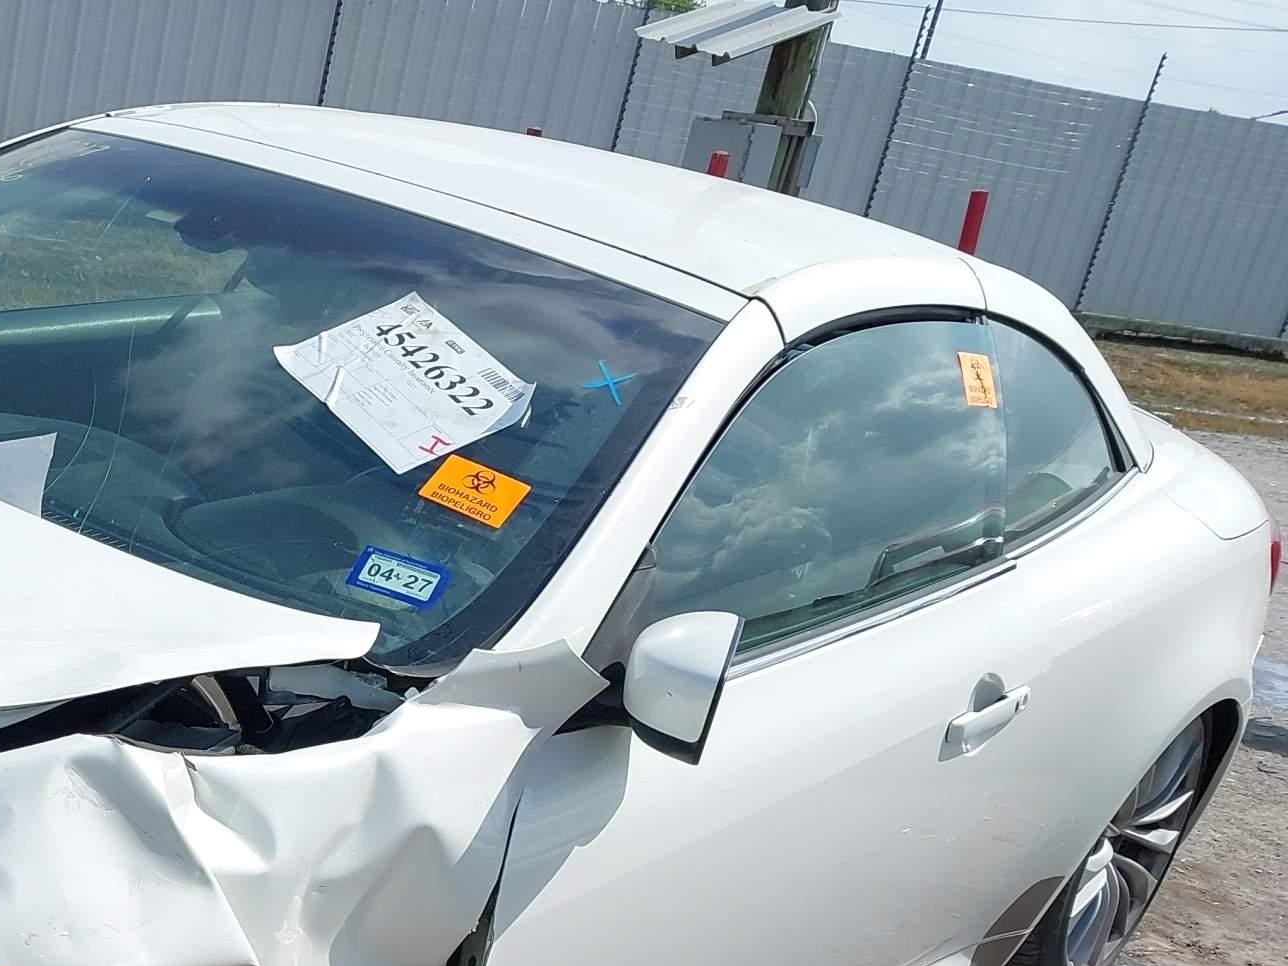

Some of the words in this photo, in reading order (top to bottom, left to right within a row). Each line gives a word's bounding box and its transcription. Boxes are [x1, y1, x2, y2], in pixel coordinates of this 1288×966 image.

[353, 323, 385, 353] Progresse
[406, 369, 436, 395] Insurance
[376, 323, 494, 416] 45426322
[430, 491, 492, 522] BIOPELIGRO
[438, 482, 499, 513] BIOHAZARD
[367, 563, 395, 582] 04
[401, 574, 434, 592] 27
